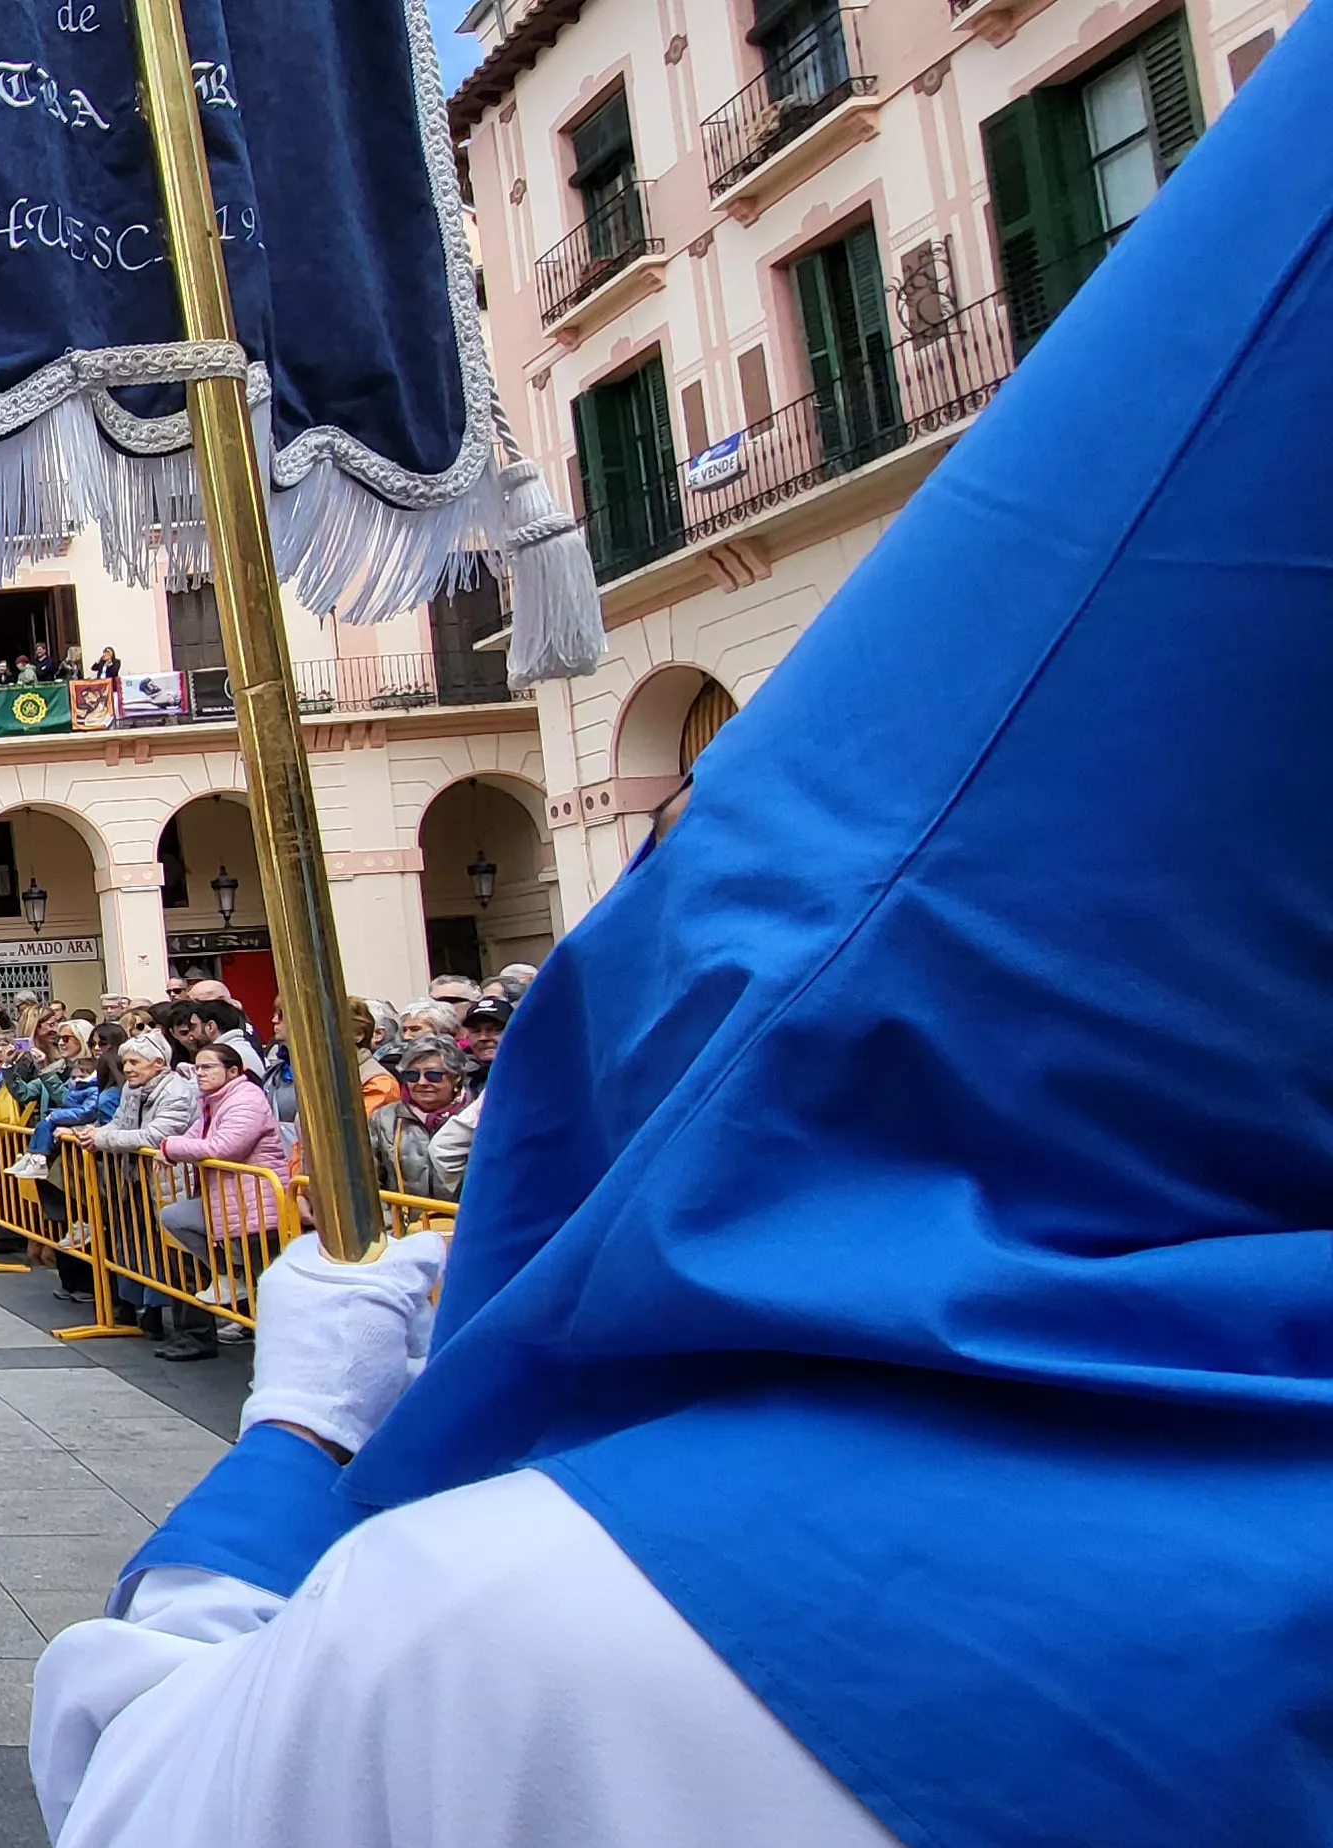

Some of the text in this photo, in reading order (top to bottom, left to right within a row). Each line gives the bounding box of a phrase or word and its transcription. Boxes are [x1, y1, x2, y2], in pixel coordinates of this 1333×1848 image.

[57, 0, 101, 33] de
[688, 456, 735, 487] SE VENDE
[17, 942, 63, 957] AMADO
[67, 941, 94, 954] ARA
